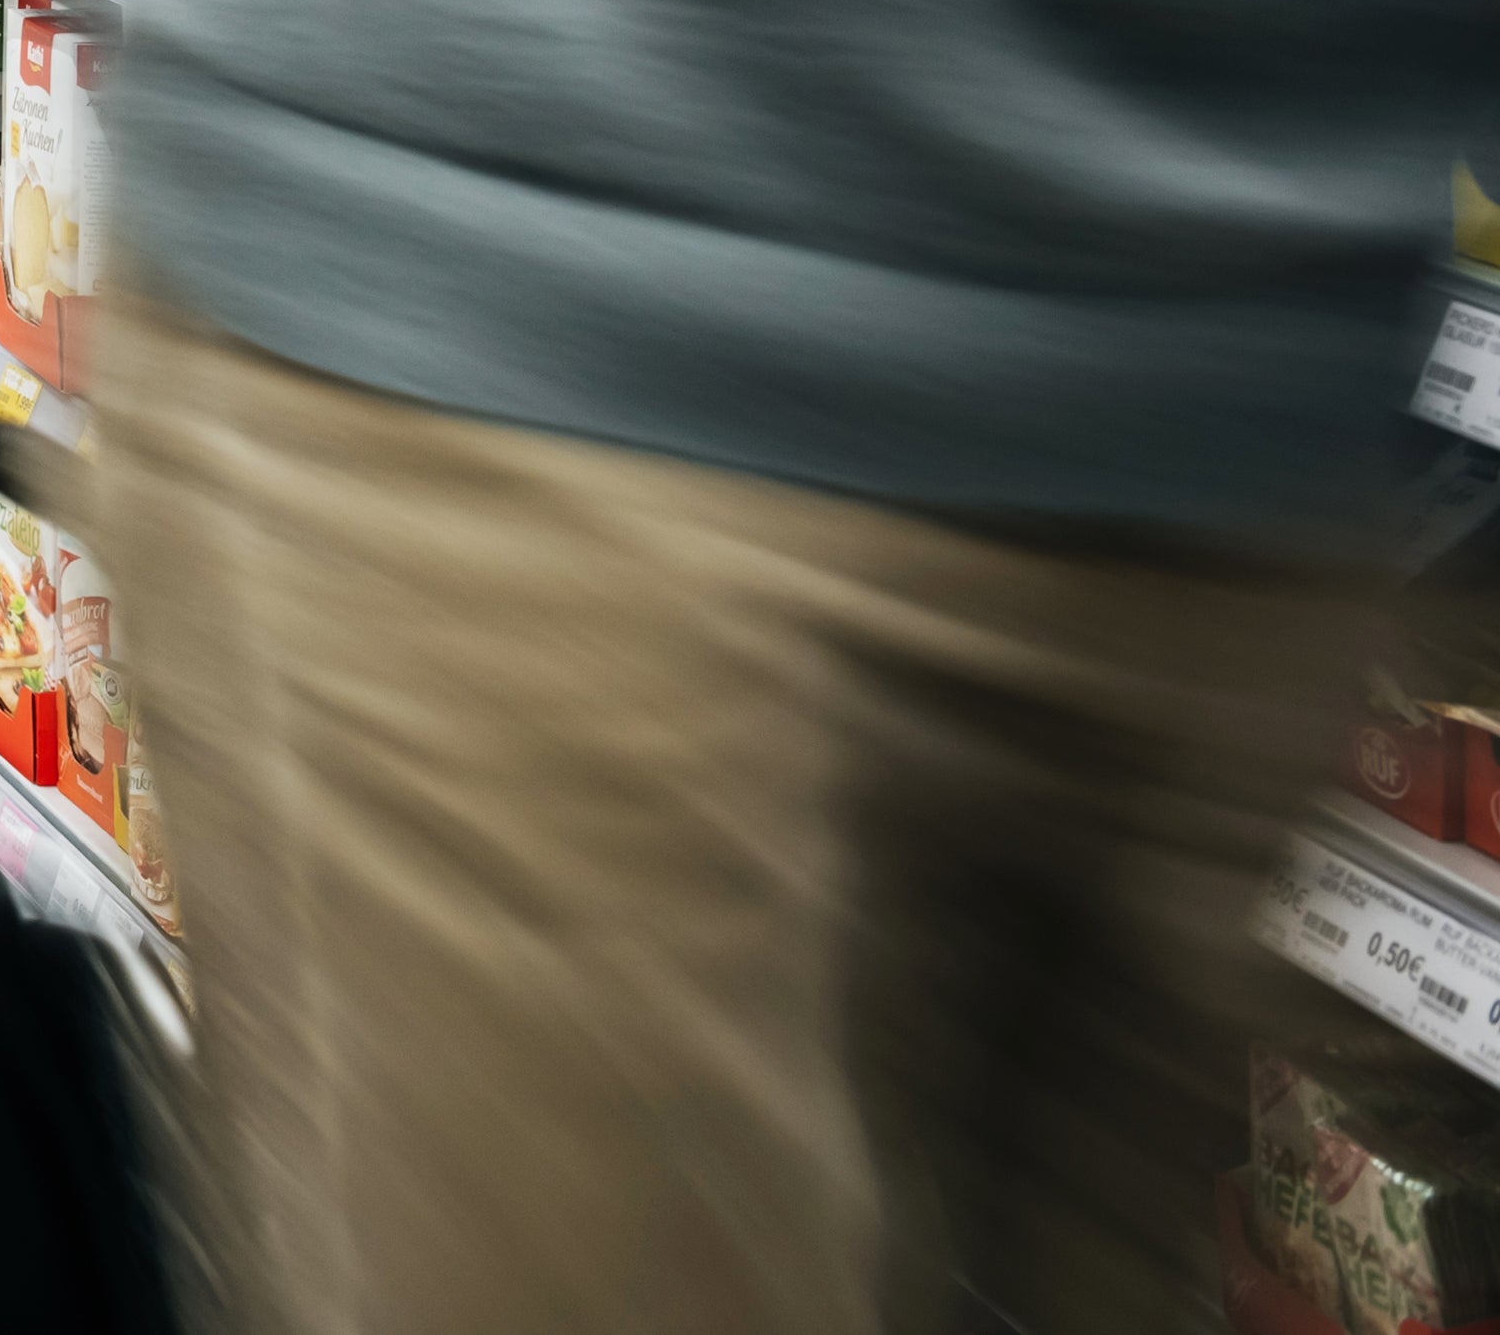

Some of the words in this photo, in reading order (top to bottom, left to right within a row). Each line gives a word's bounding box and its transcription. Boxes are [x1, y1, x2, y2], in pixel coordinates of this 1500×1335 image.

[27, 42, 44, 66] Kathi
[12, 87, 49, 119] Zitronen
[1361, 750, 1402, 788] RUF
[1367, 931, 1425, 983] 0,50€
